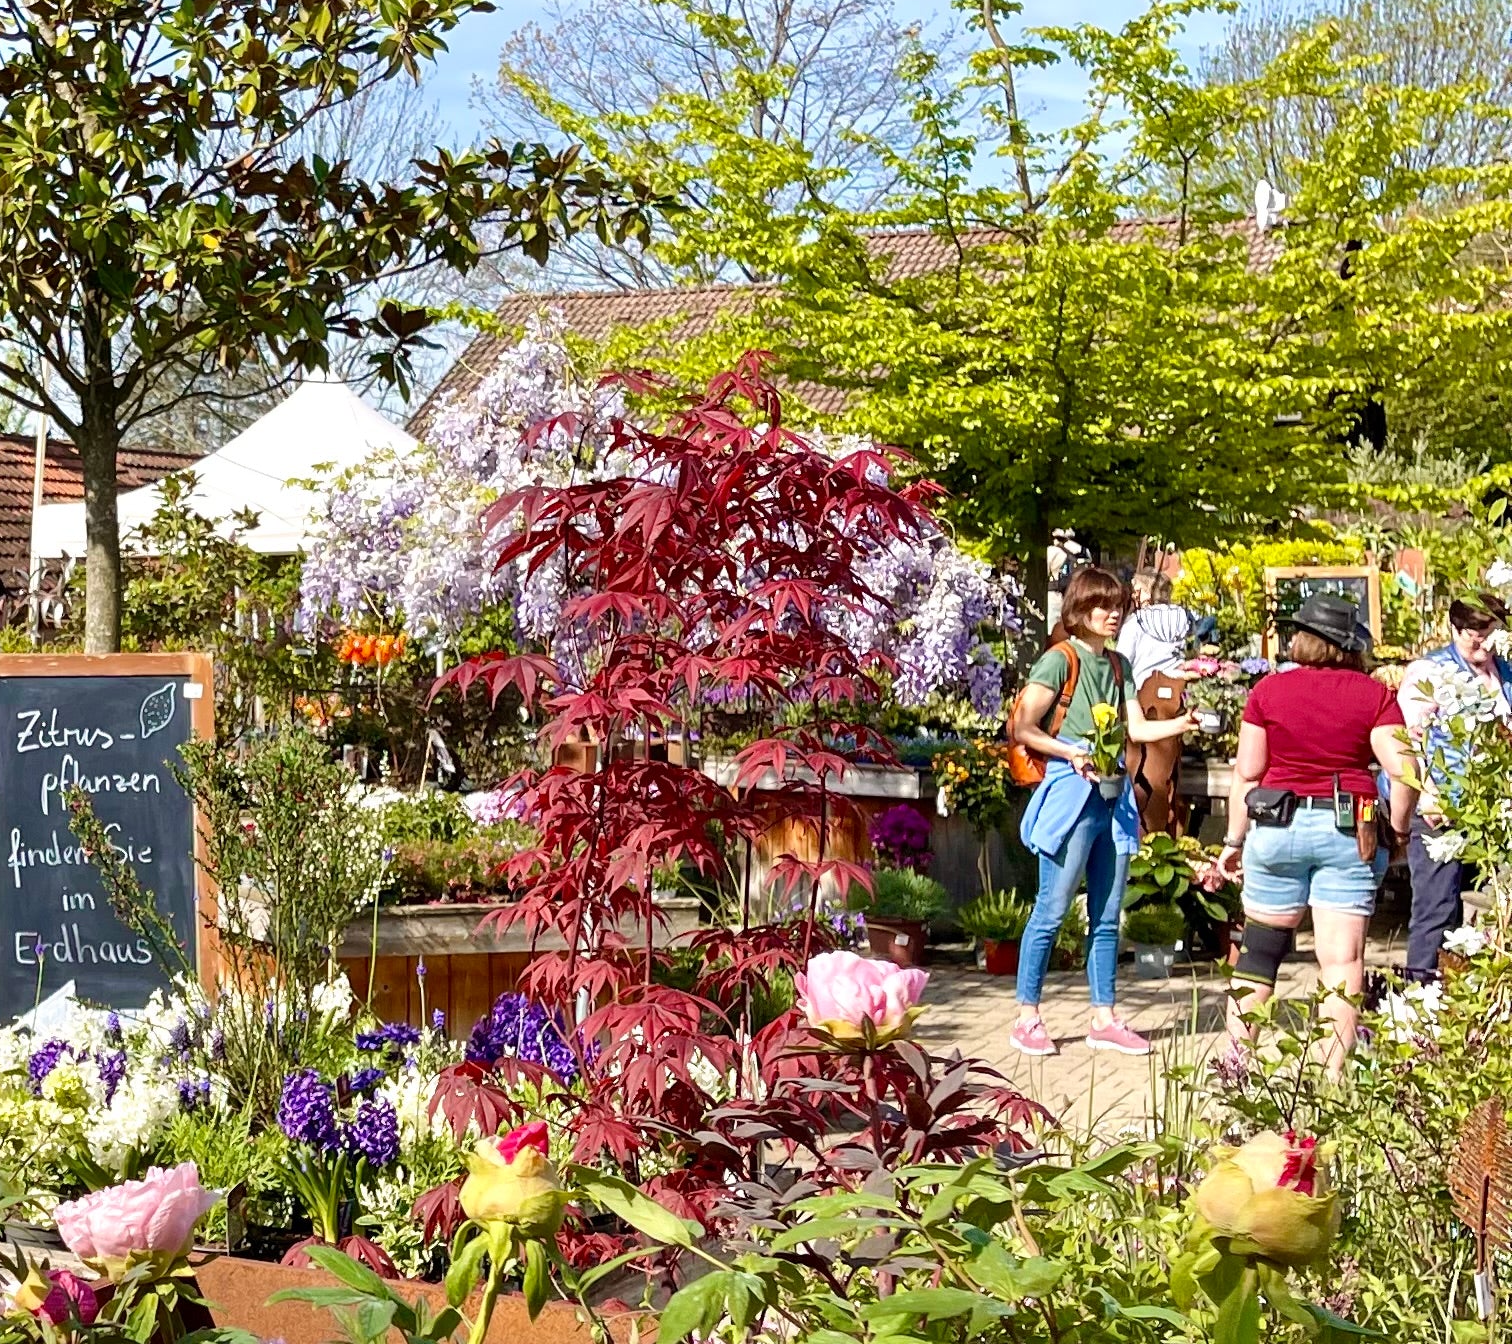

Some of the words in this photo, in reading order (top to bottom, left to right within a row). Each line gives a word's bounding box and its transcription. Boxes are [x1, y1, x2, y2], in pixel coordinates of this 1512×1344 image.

[16, 707, 135, 753] Zitrus-
[40, 754, 160, 816] pflanzen
[7, 827, 89, 888] finden
[103, 822, 153, 864] Sie
[61, 885, 96, 912] im
